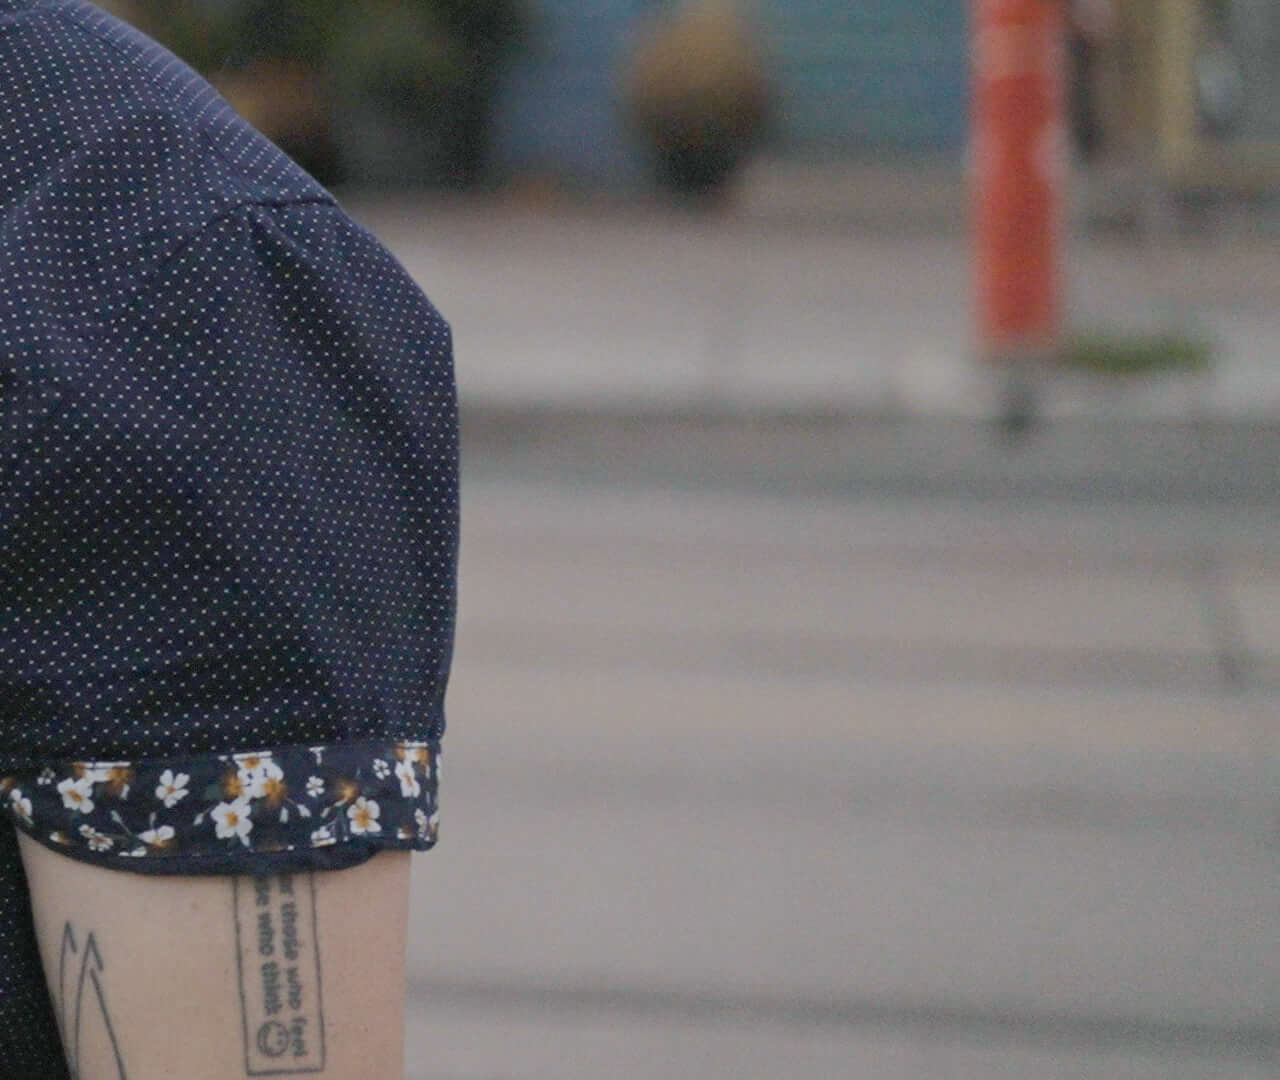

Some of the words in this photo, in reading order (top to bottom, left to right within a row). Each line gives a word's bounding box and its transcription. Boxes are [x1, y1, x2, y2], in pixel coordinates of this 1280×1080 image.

[258, 912, 275, 956] who
[261, 961, 282, 1016] think
[286, 966, 302, 1010] who
